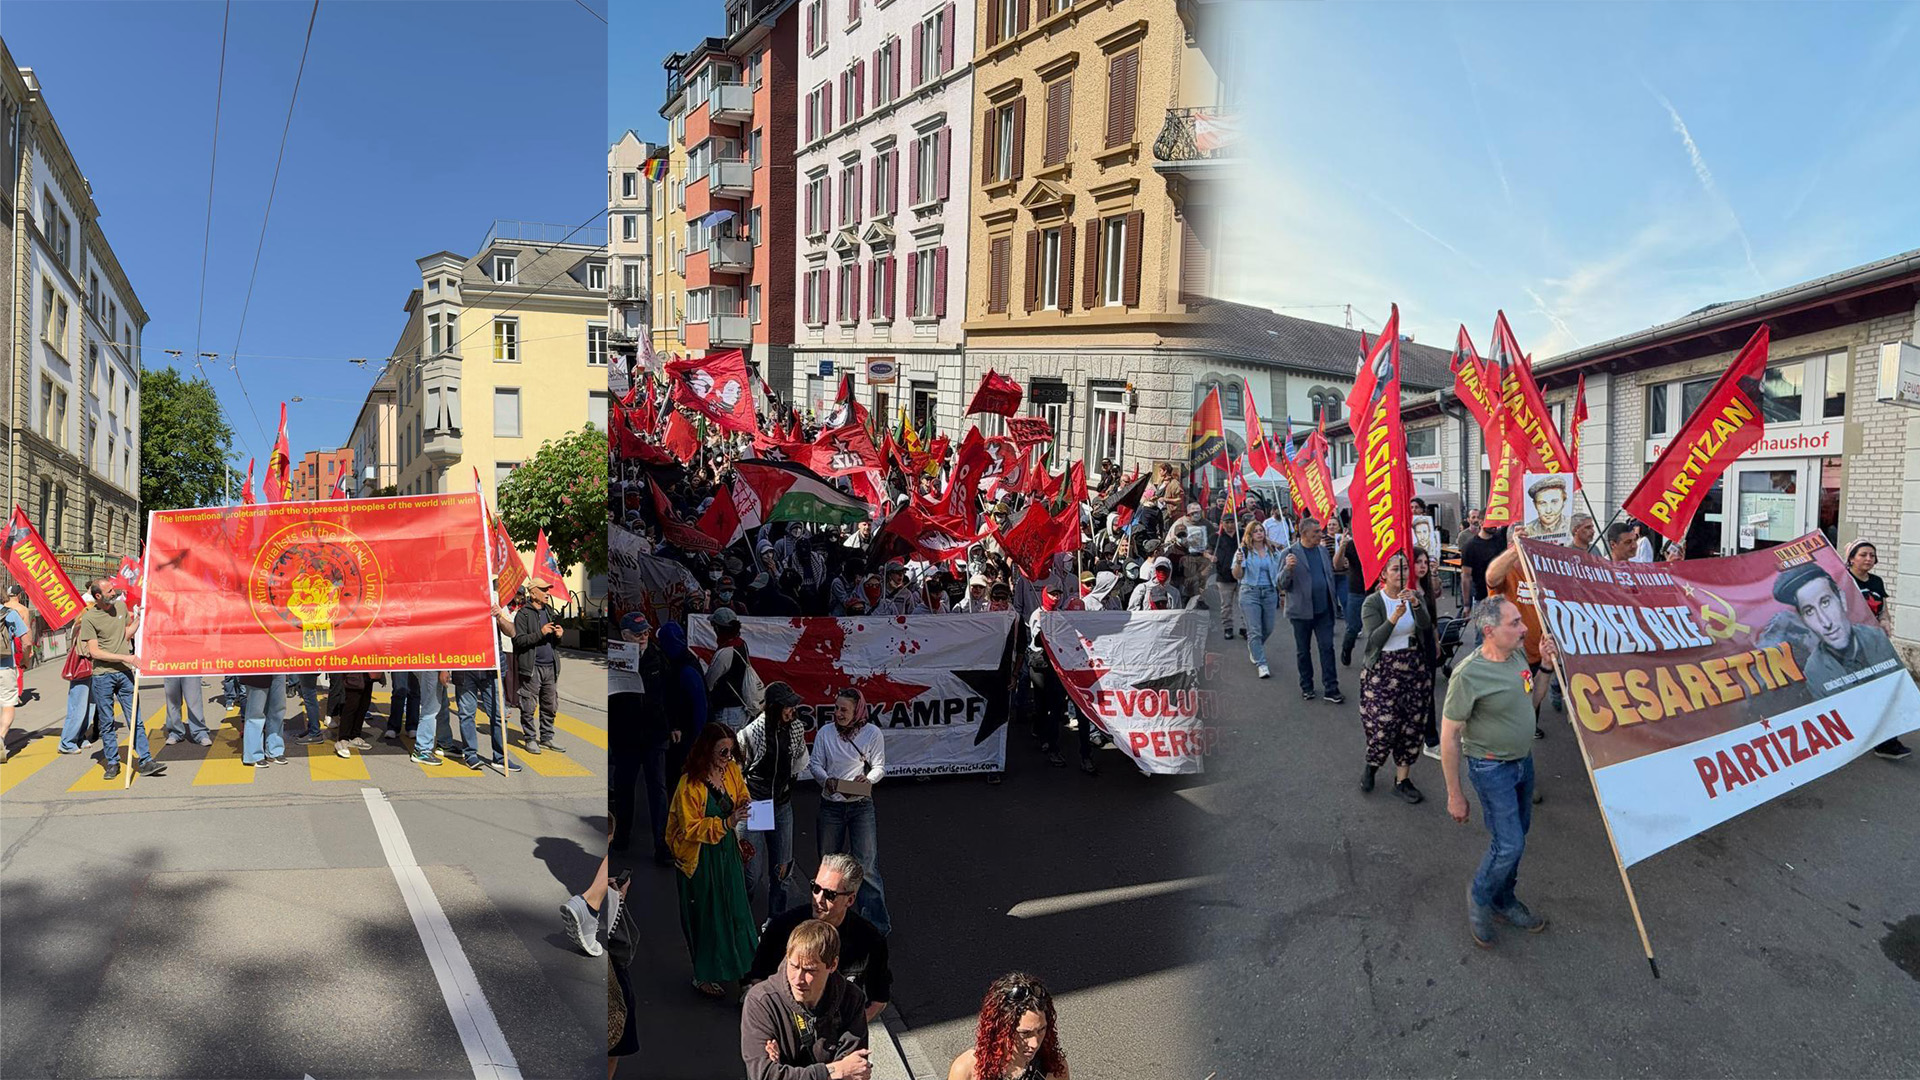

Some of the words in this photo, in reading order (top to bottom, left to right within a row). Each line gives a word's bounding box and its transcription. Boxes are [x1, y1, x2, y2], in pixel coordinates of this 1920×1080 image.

[158, 514, 173, 523] The
[175, 512, 223, 523] international
[225, 509, 267, 520] proletariat
[269, 508, 284, 516] and
[287, 507, 300, 515] the
[303, 505, 349, 516] oppressed
[351, 503, 385, 513] peoples
[399, 501, 412, 509] the
[415, 499, 438, 508] world
[441, 498, 456, 506] will
[458, 496, 476, 505] win!
[302, 527, 314, 539] of
[317, 527, 337, 540] the
[1775, 537, 1822, 560] UNUTMA
[149, 659, 198, 671] Forward
[202, 658, 212, 669] in
[215, 658, 234, 669] the
[237, 656, 312, 668] construction
[315, 655, 327, 666] of
[330, 655, 348, 666] the
[351, 652, 435, 667] Antiimperialist
[439, 652, 486, 666] League!
